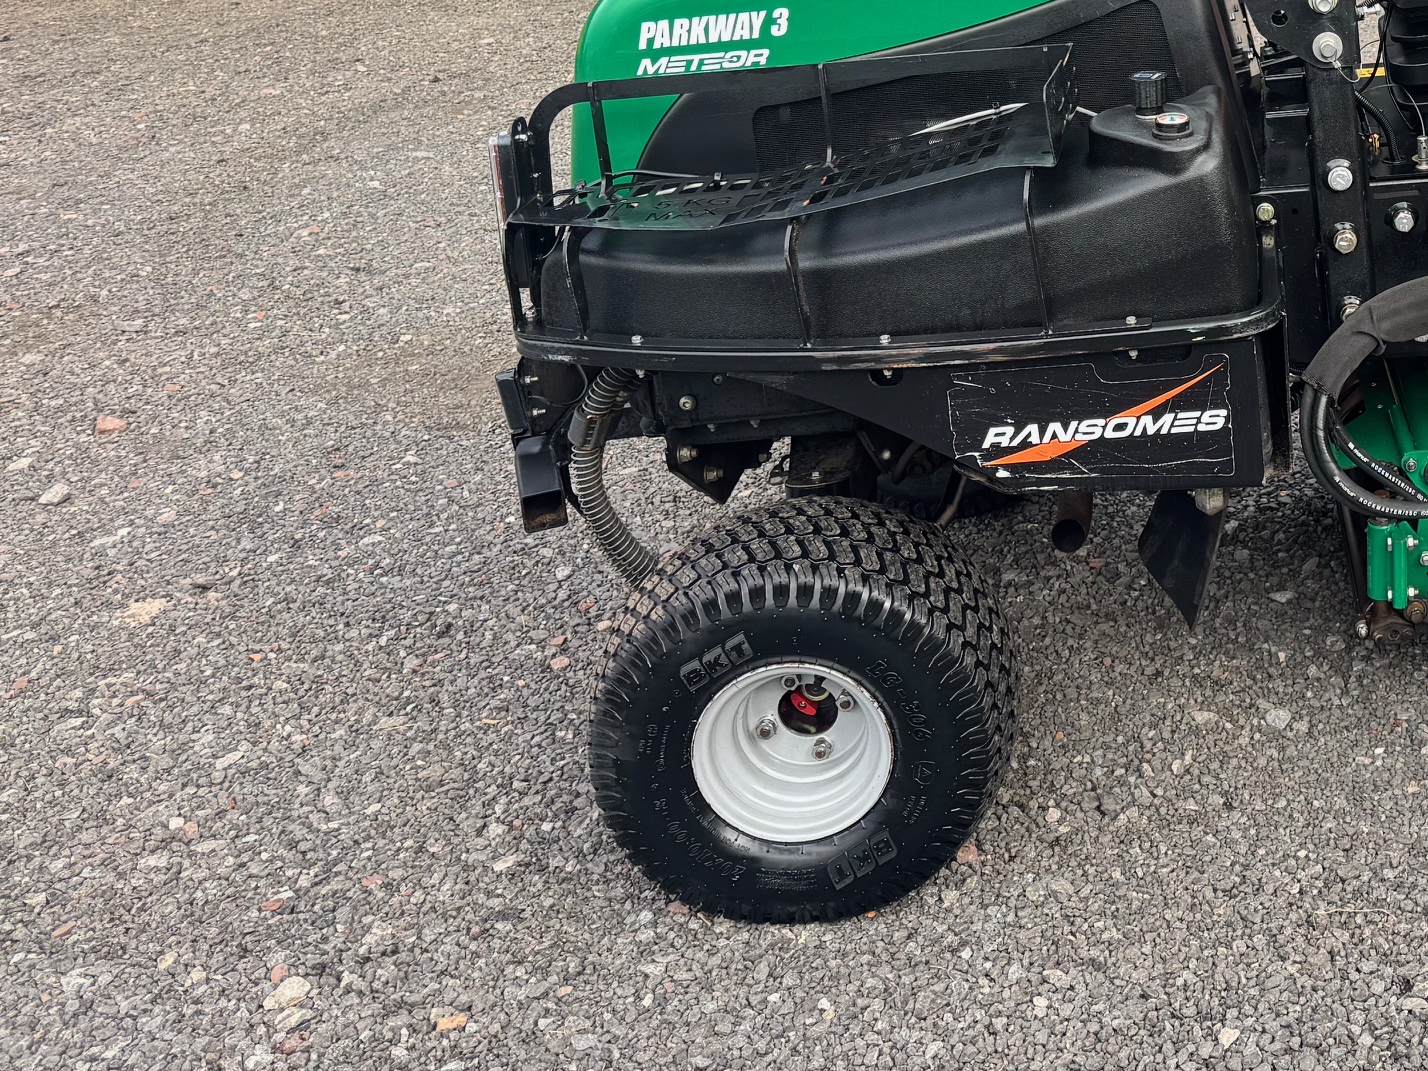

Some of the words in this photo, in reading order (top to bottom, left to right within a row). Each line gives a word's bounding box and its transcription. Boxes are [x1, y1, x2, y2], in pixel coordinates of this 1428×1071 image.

[638, 9, 767, 51] PARKWAY
[770, 7, 790, 37] 3
[636, 48, 770, 76] METEOR
[644, 207, 718, 222] MAX
[682, 196, 733, 208] KG
[981, 408, 1228, 449] RANSOMES
[679, 630, 755, 693] BKT
